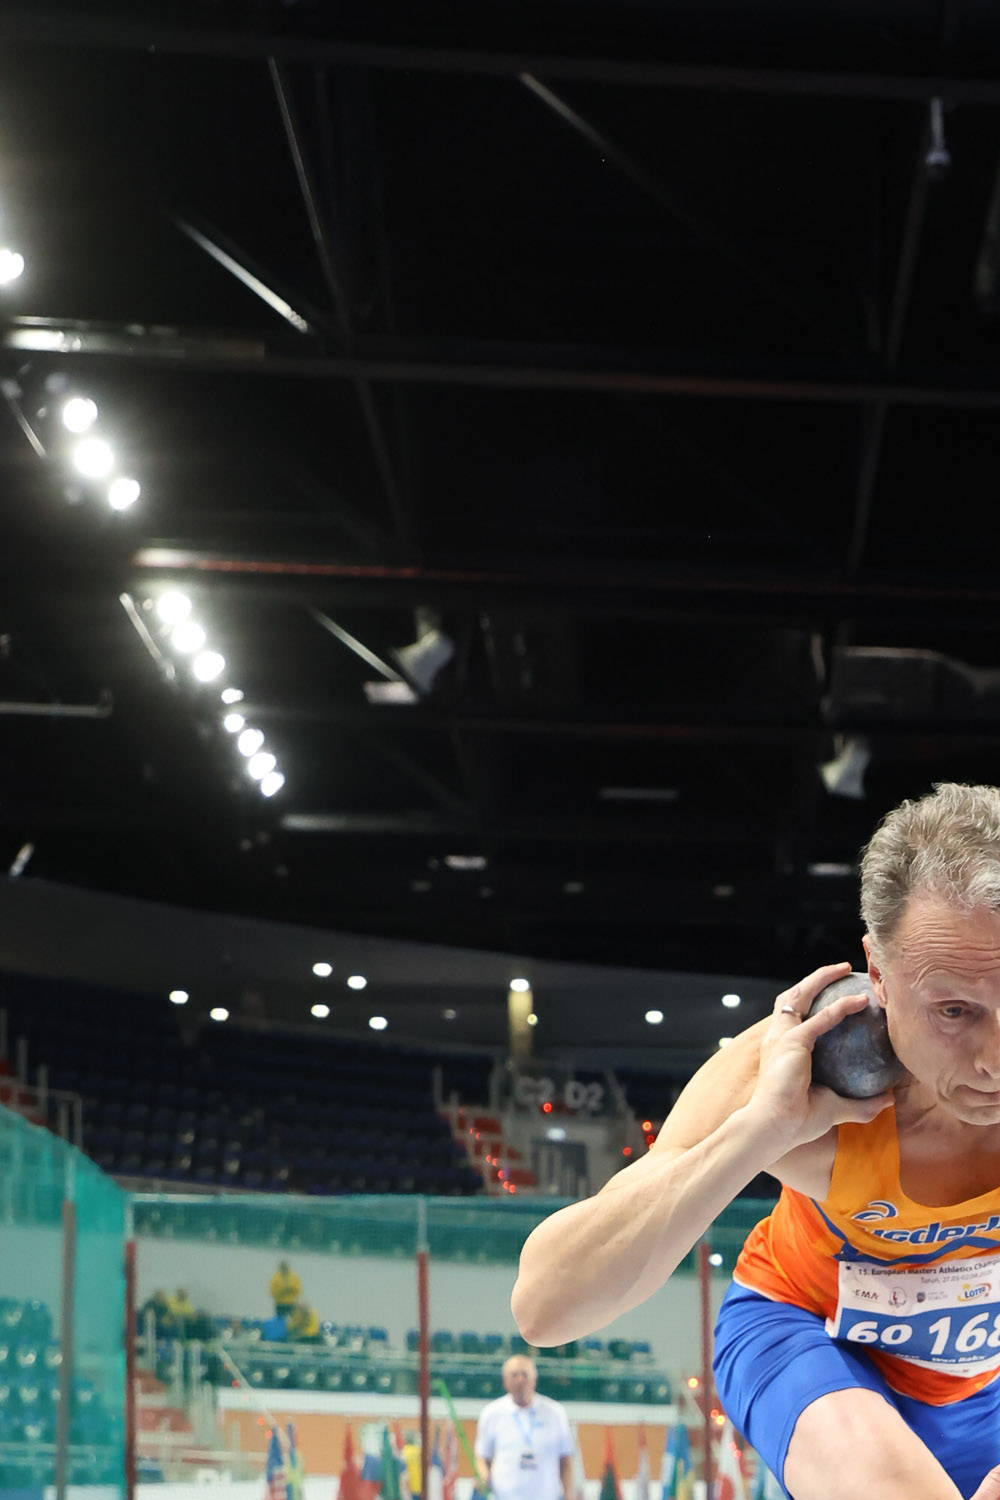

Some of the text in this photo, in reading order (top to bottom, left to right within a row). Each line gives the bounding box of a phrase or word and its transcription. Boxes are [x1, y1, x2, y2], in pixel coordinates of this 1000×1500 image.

[872, 1268, 906, 1277] European
[855, 1289, 880, 1300] EMA
[964, 1286, 986, 1299] LOTTO
[847, 1321, 913, 1345] 60
